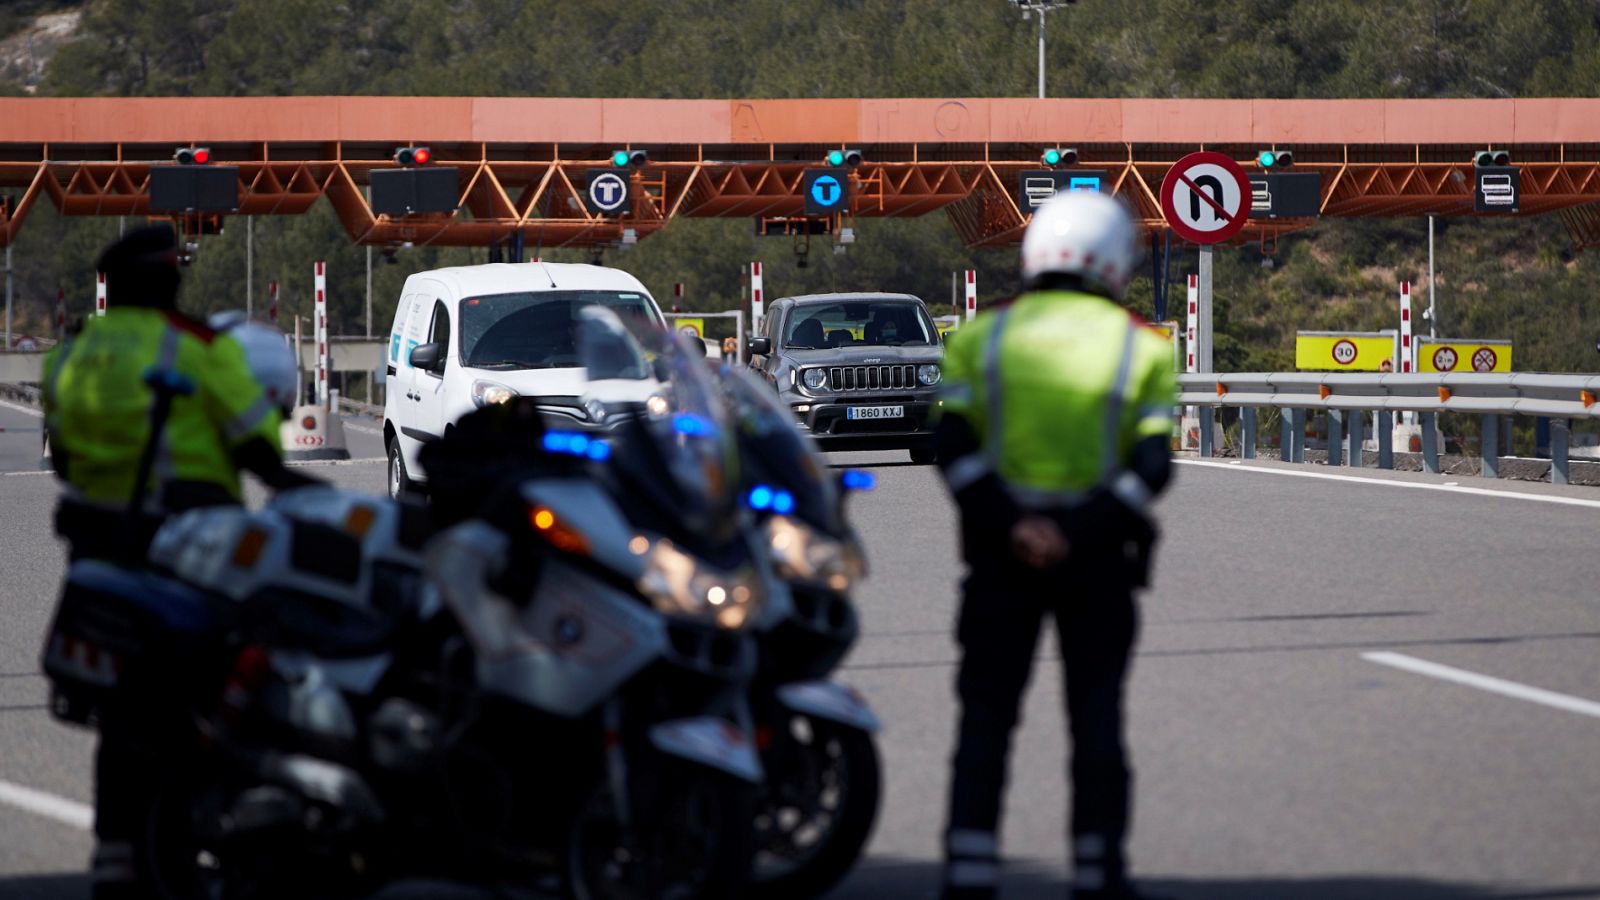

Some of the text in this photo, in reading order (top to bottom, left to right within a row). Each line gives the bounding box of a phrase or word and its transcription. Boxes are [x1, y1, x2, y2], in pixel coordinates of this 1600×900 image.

[598, 182, 619, 202] T
[816, 182, 837, 200] T
[1337, 347, 1353, 357] 30
[855, 407, 902, 418] 1860 KXJ
